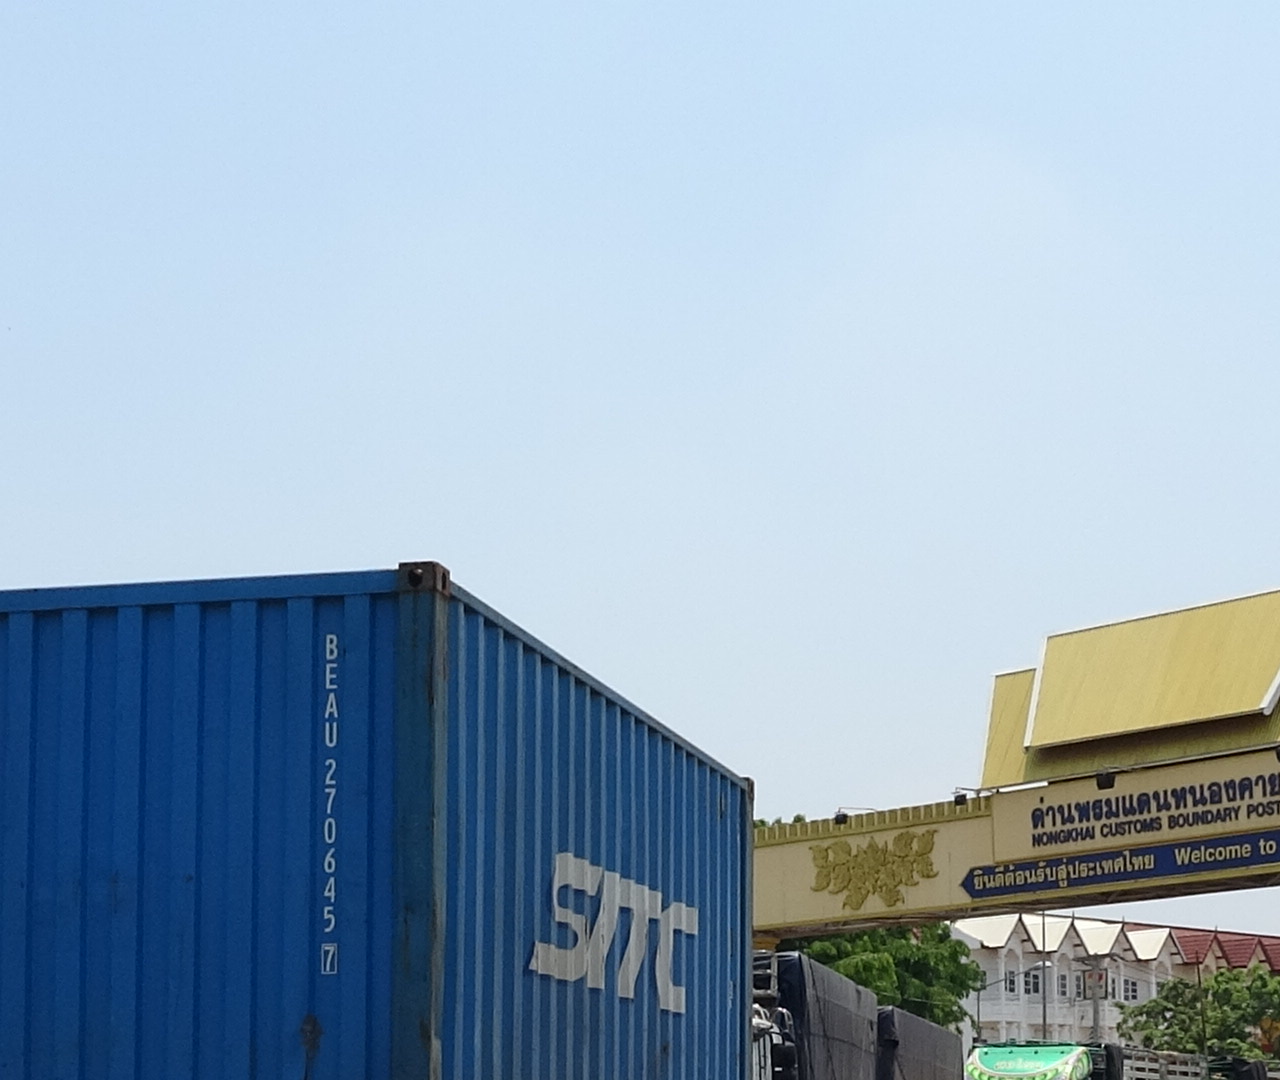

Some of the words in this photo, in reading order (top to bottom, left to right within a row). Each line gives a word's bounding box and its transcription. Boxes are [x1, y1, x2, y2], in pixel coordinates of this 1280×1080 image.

[324, 633, 339, 748] BEAU
[323, 758, 337, 933] 270645
[1031, 825, 1096, 848] NONGKHAI
[1099, 816, 1163, 838] CUSTOMS
[1167, 805, 1241, 830] BOUNDARY
[972, 850, 1156, 890] ยินดีต้อนรับสู่ประเทศไทย
[1174, 842, 1252, 866] Welcome
[1258, 838, 1277, 856] to
